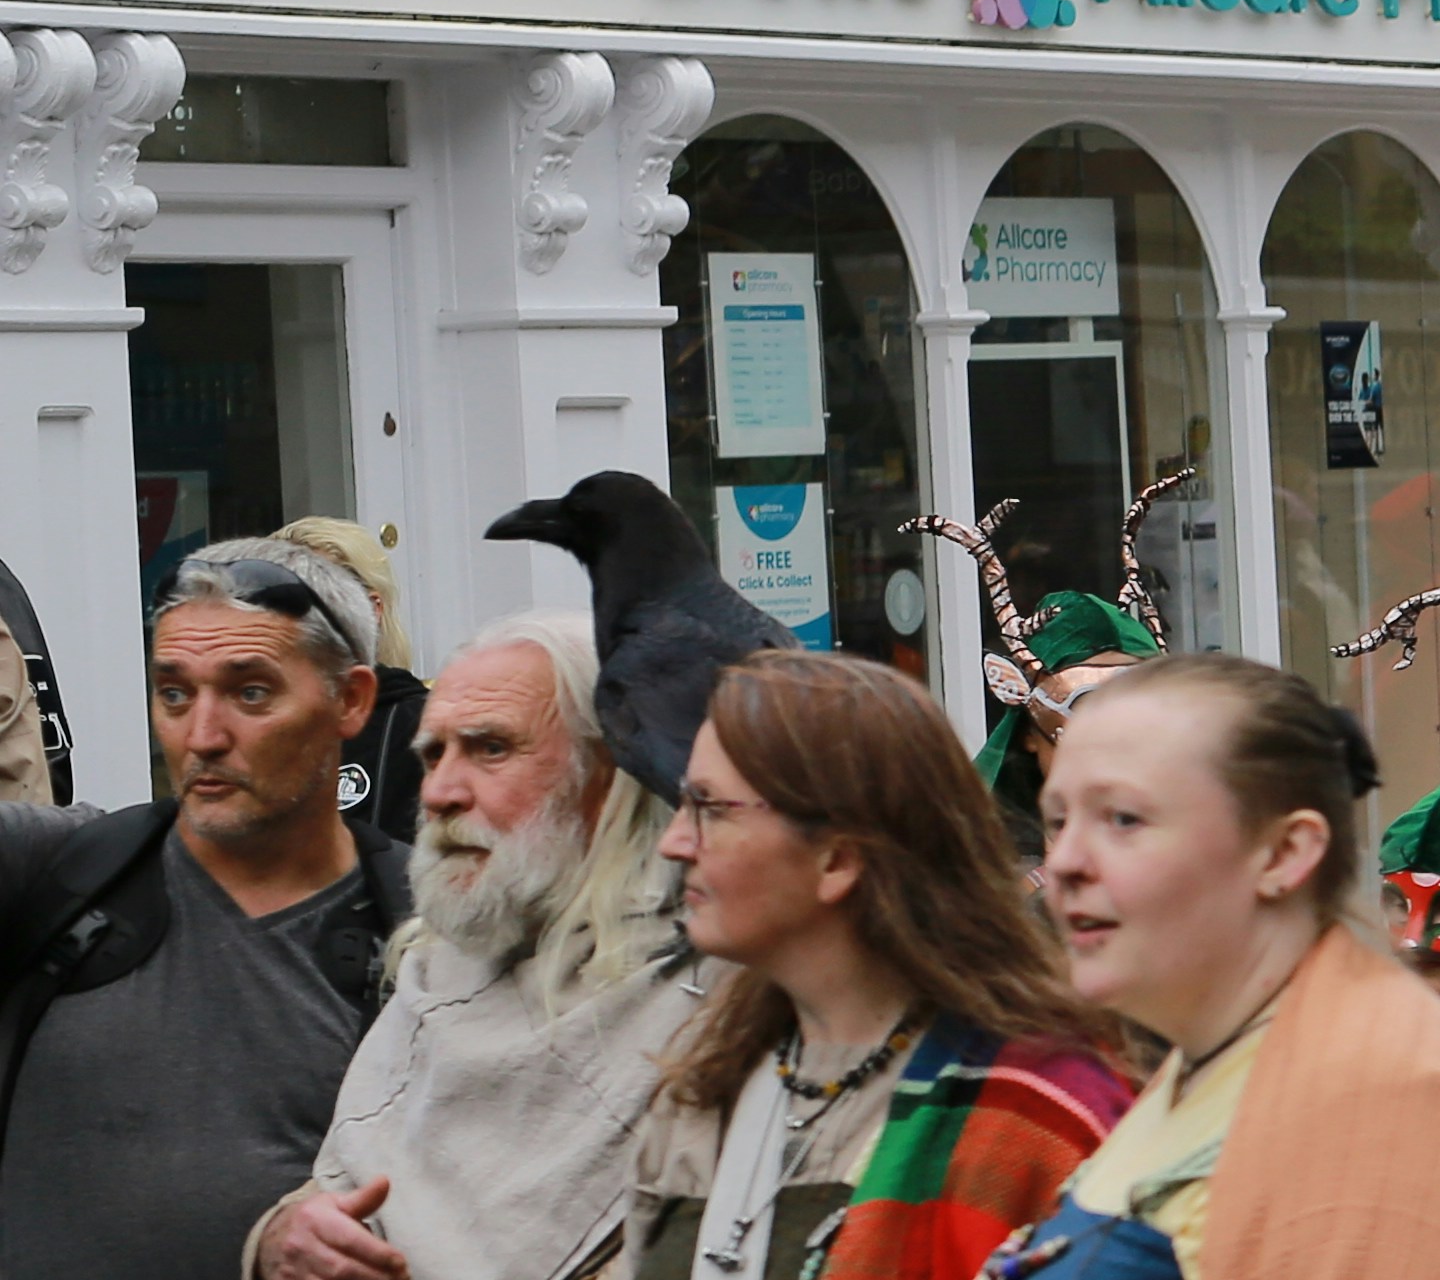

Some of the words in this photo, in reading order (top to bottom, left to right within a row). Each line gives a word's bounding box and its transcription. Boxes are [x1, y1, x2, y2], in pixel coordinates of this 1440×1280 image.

[996, 223, 1068, 249] Allcare
[996, 257, 1106, 288] Pharmacy
[757, 551, 792, 570] FREE
[738, 575, 764, 590] Click
[767, 575, 774, 588] &
[776, 574, 812, 587] Collect
